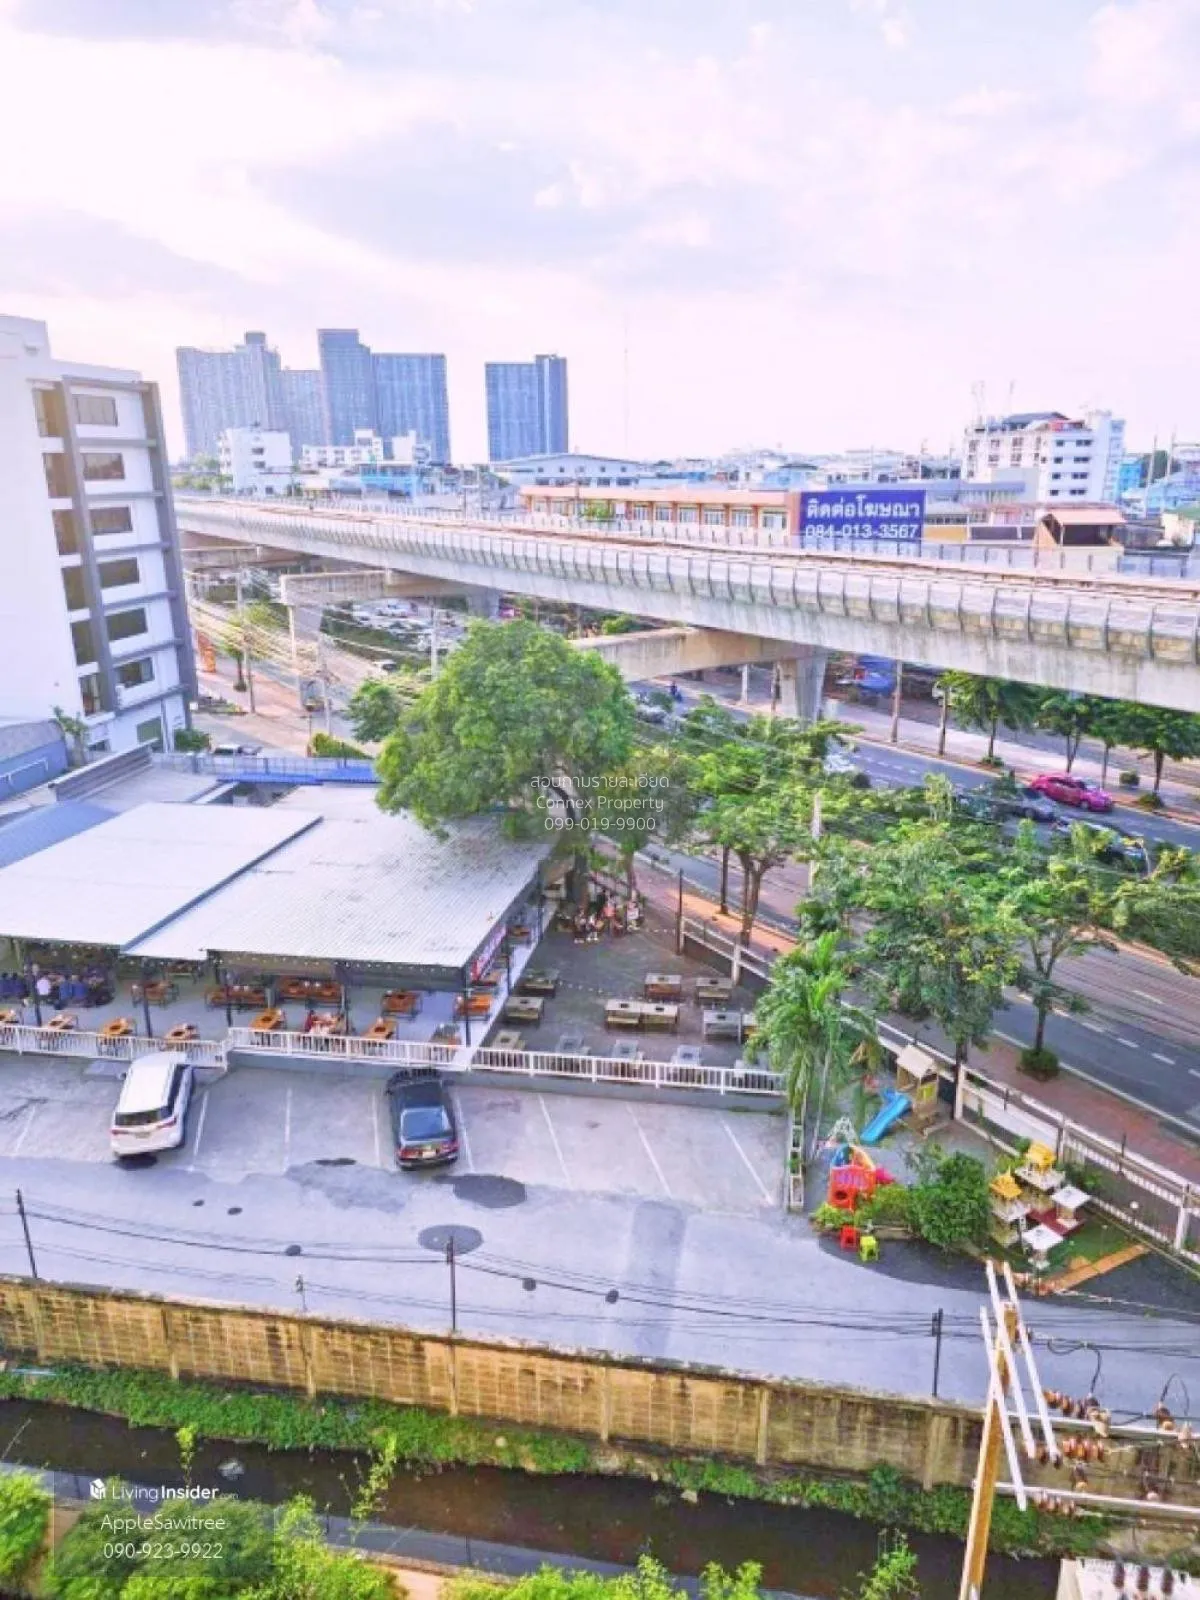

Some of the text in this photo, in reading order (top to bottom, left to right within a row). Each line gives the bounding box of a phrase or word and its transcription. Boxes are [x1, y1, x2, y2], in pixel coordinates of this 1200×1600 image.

[807, 494, 920, 518] ติดต่อโฆษณา
